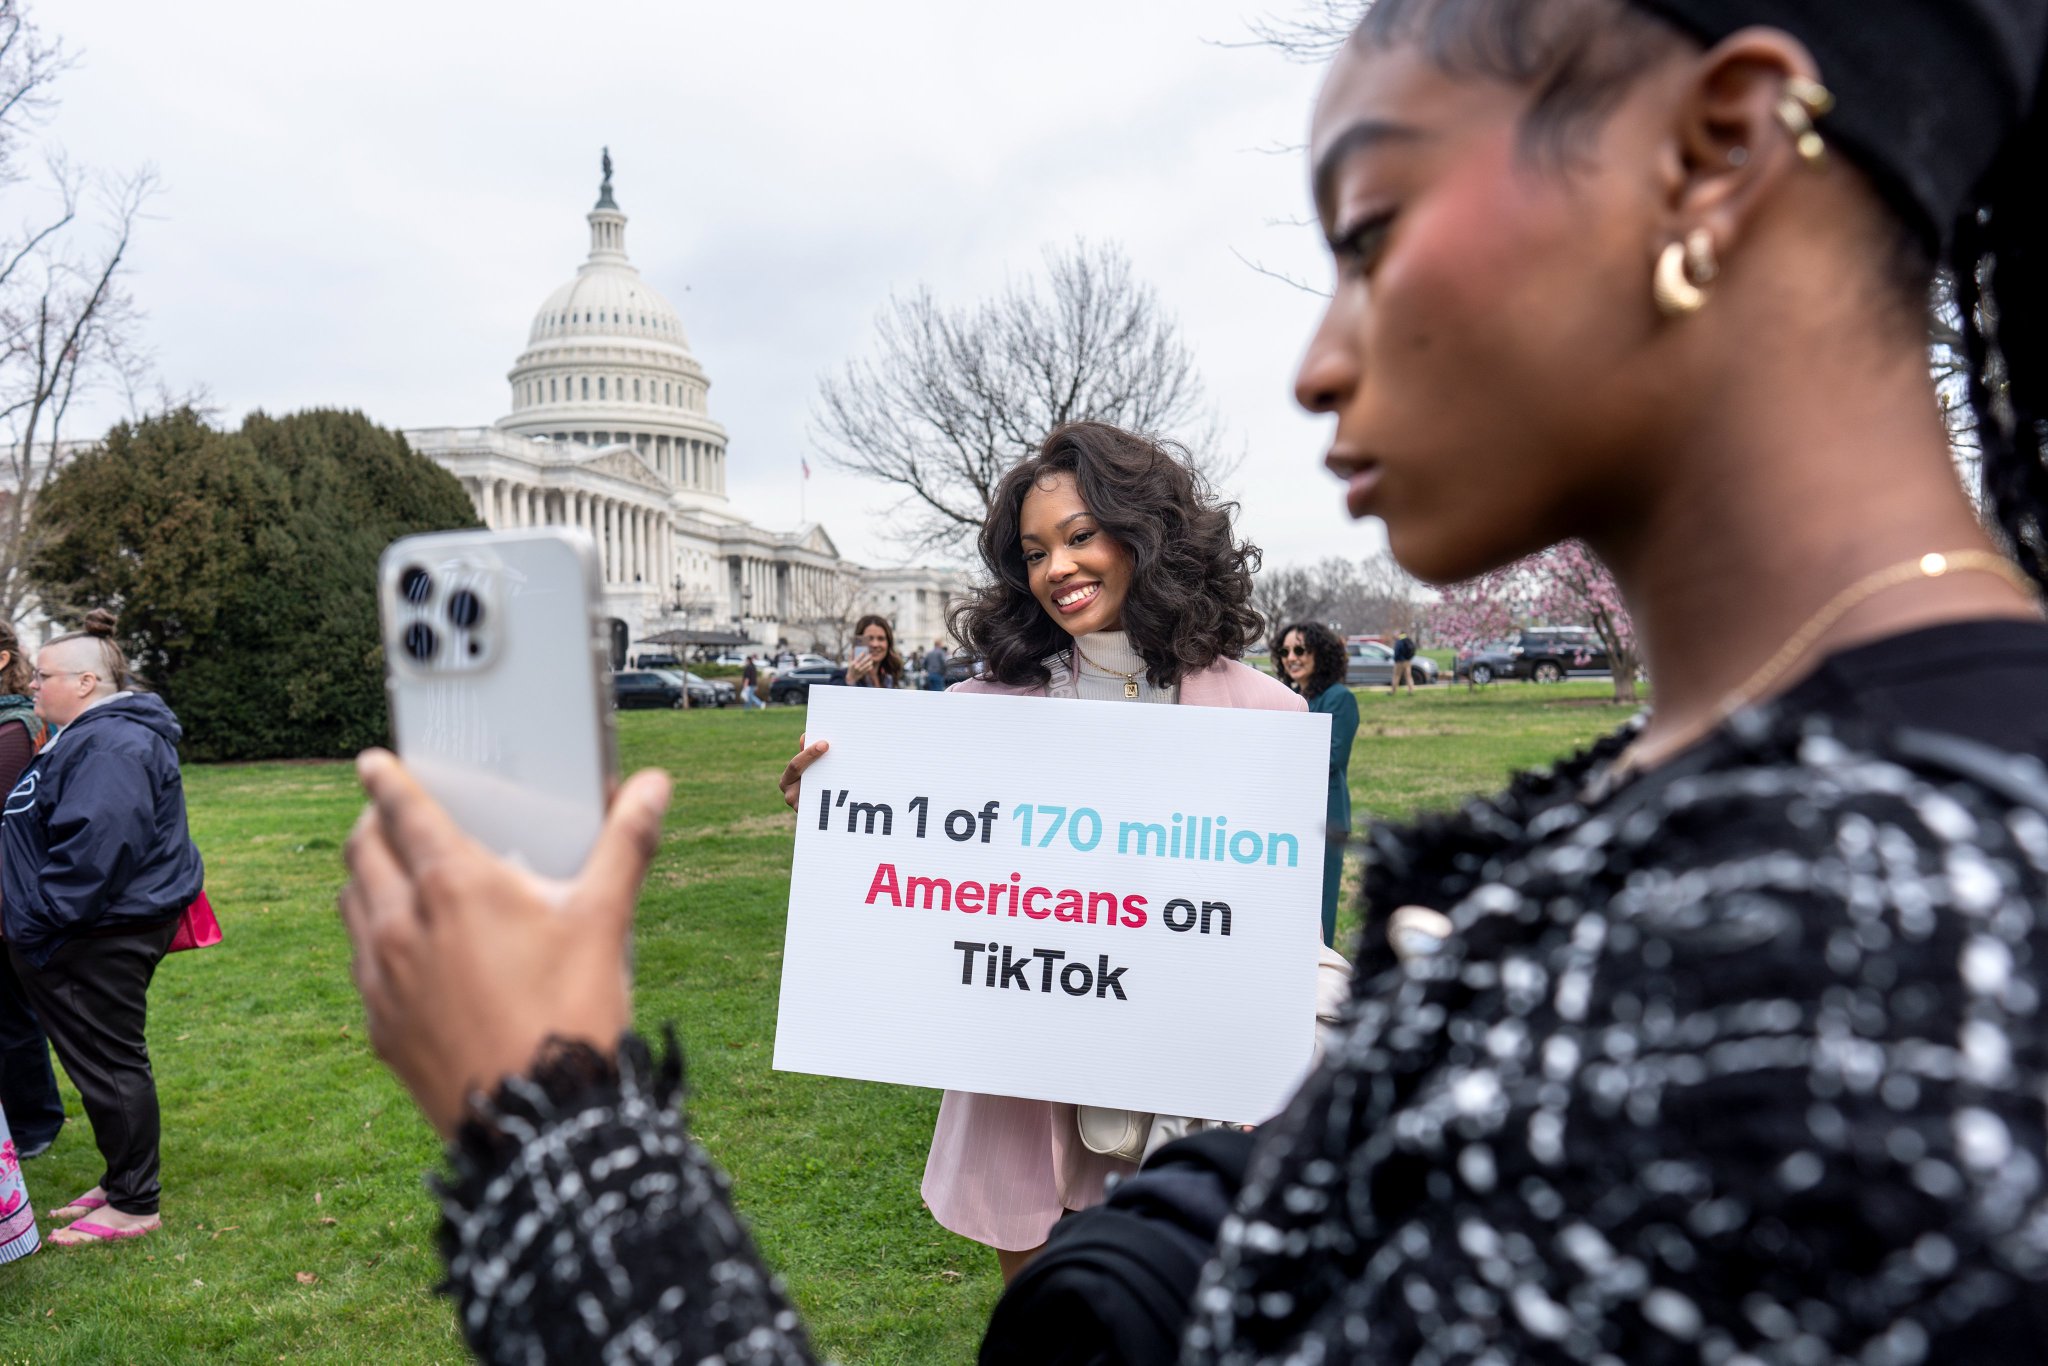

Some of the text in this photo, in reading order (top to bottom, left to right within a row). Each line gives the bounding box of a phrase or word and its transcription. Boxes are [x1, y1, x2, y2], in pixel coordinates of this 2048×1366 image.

[818, 789, 1299, 868] I’m 1 of 170 million
[864, 862, 1232, 937] Americans on
[953, 940, 1130, 1001] TikTok
